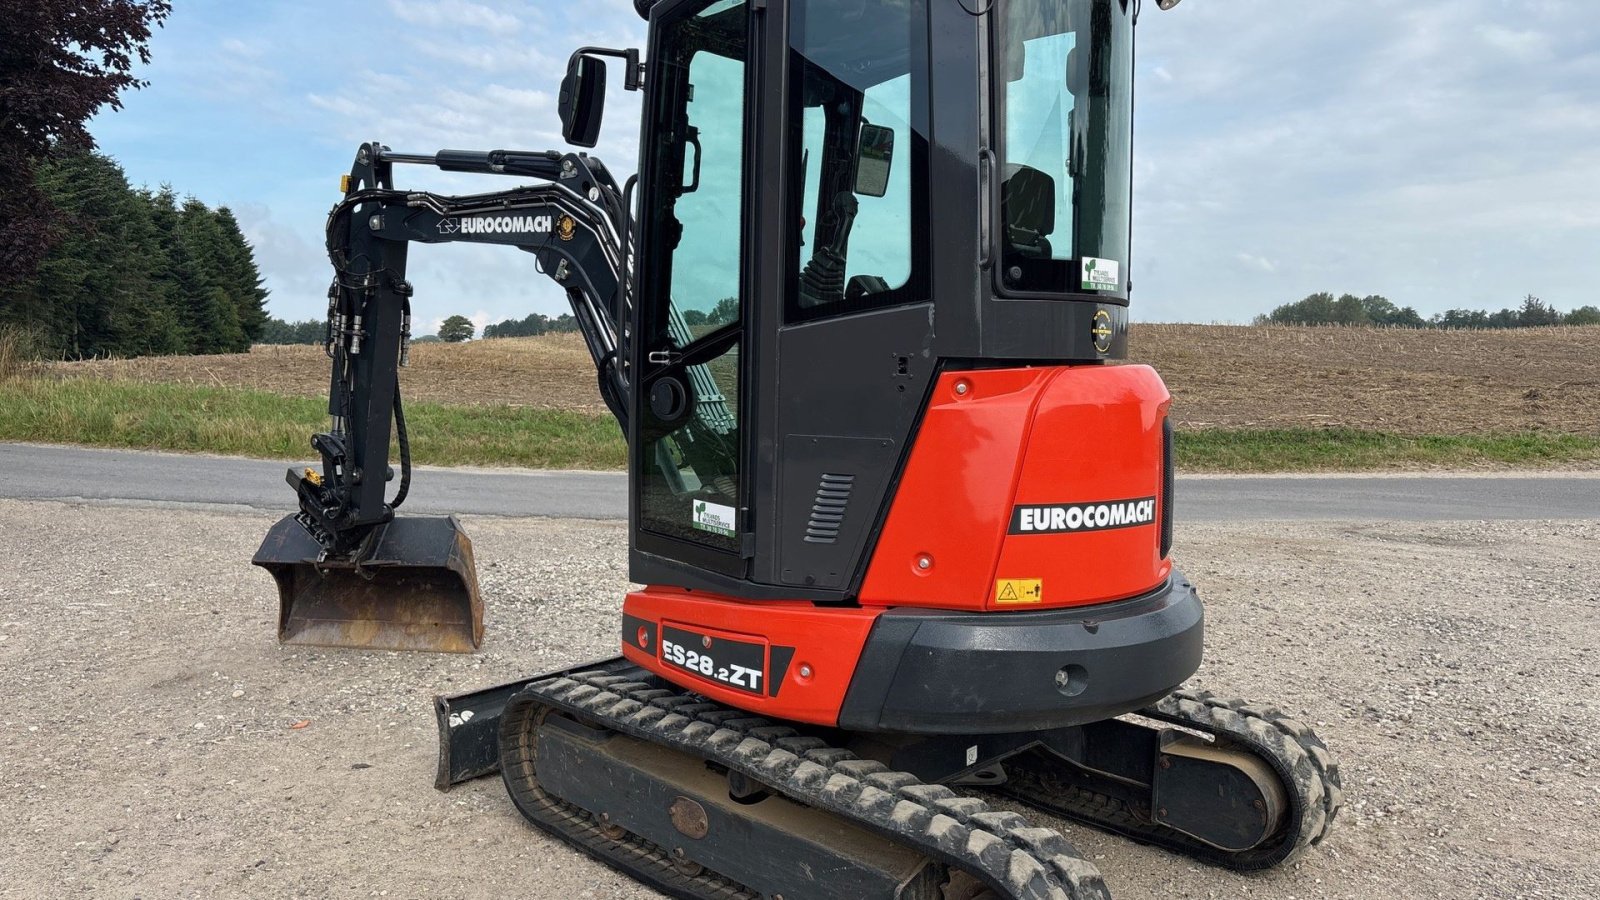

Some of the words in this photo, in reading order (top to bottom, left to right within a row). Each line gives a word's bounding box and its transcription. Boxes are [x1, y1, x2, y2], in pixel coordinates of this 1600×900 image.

[461, 215, 552, 233] EUROCOMACH
[1020, 500, 1154, 531] EUROCOMACH
[662, 639, 762, 689] ES28.2ZT
